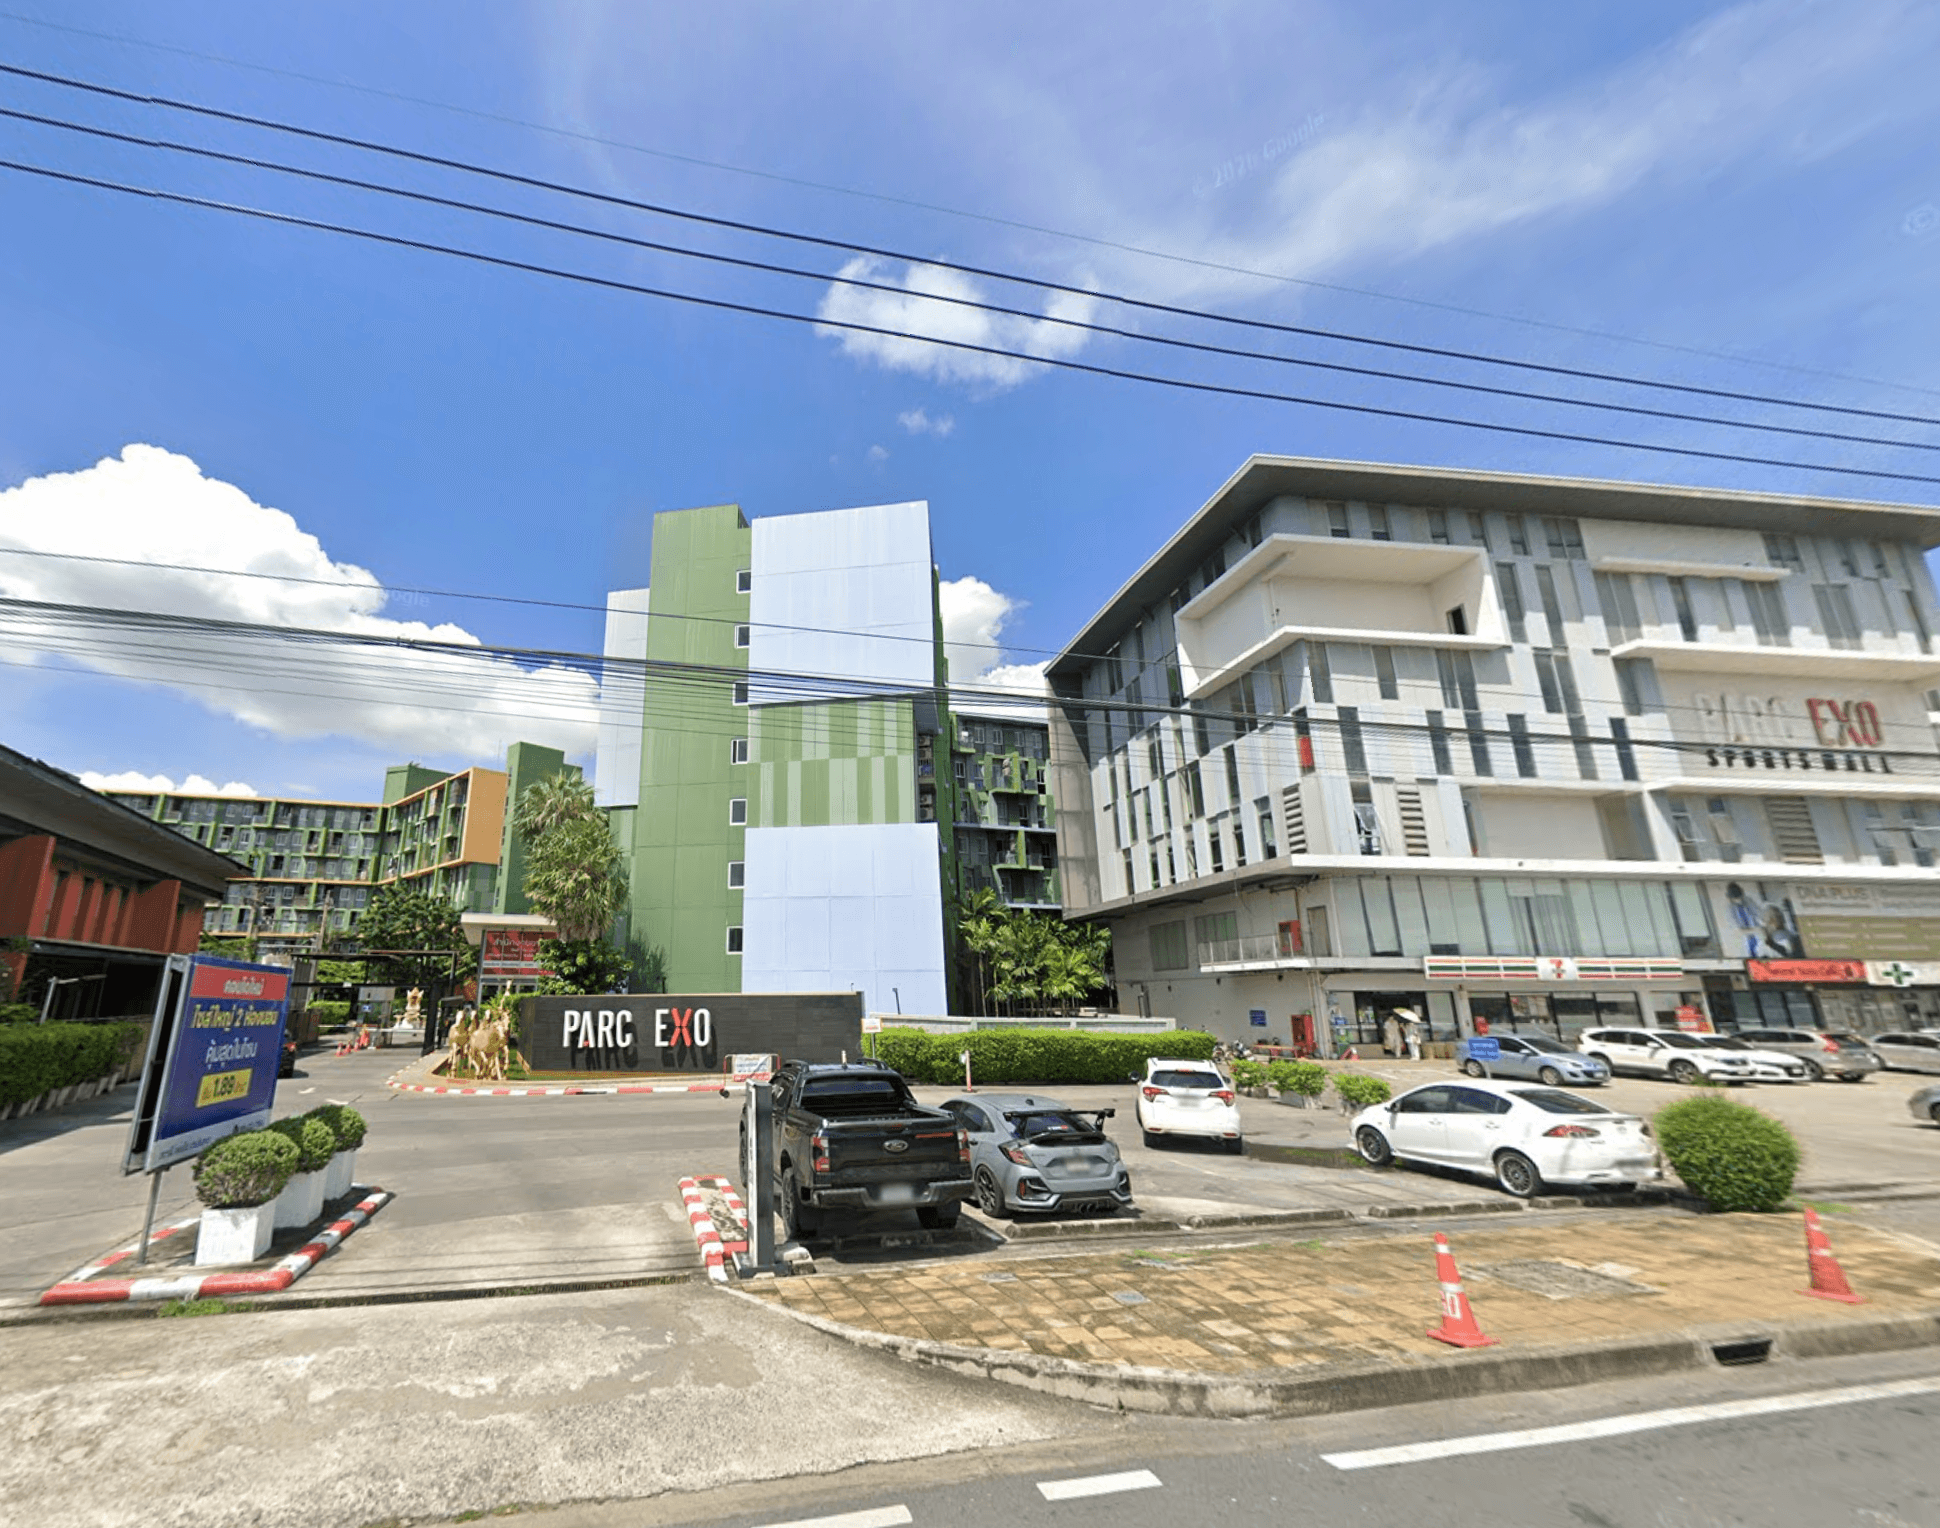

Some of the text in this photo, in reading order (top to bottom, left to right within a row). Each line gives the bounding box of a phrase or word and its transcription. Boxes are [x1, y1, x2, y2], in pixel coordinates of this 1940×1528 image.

[1805, 697, 1886, 748] EXO
[235, 1007, 244, 1027] 2
[562, 1007, 712, 1049] PARC EXO
